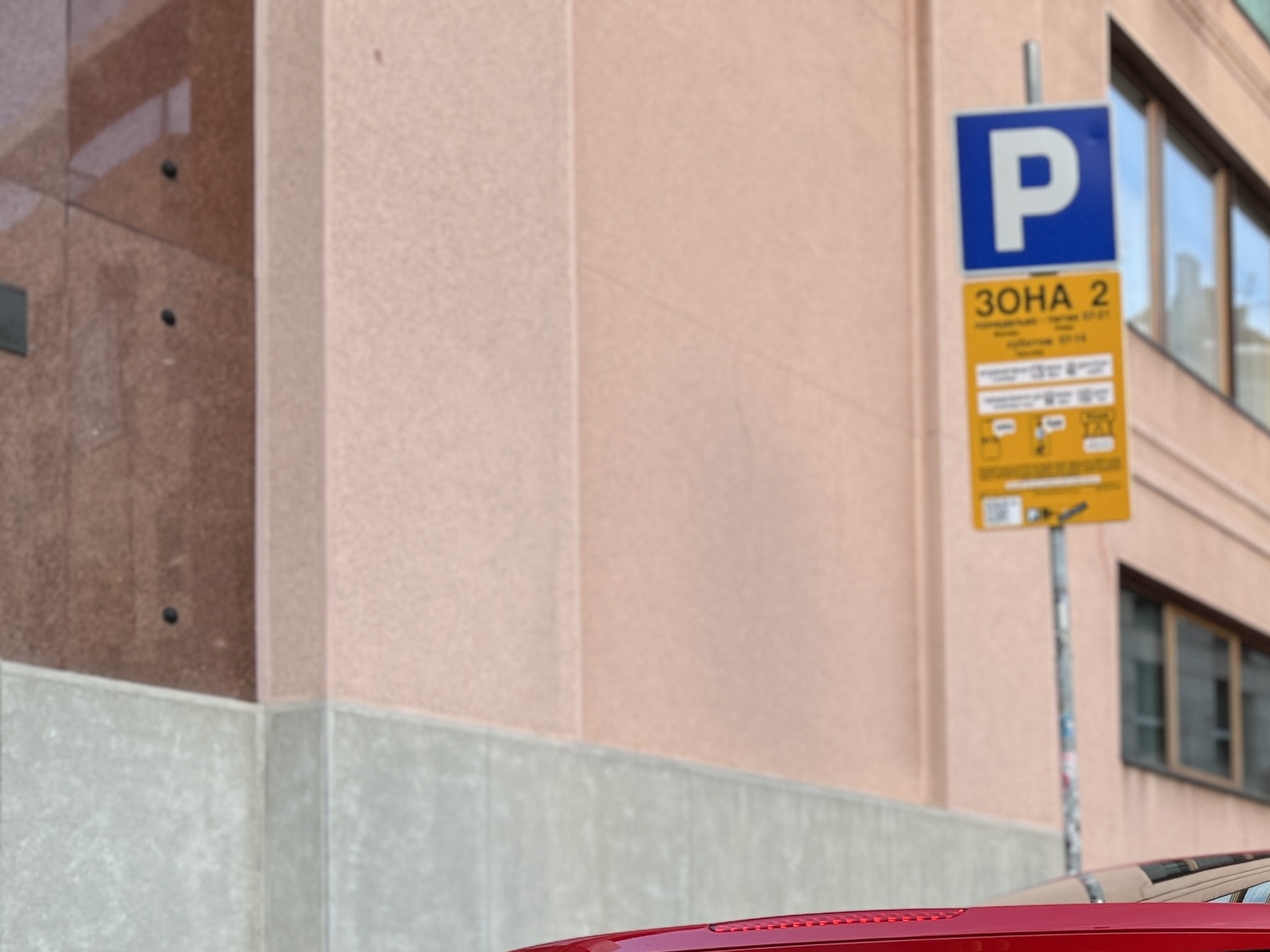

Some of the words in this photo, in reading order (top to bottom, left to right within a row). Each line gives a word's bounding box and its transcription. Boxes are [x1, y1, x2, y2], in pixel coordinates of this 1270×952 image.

[989, 127, 1080, 252] P
[975, 283, 1072, 317] ЗОНА
[1091, 280, 1109, 306] 2
